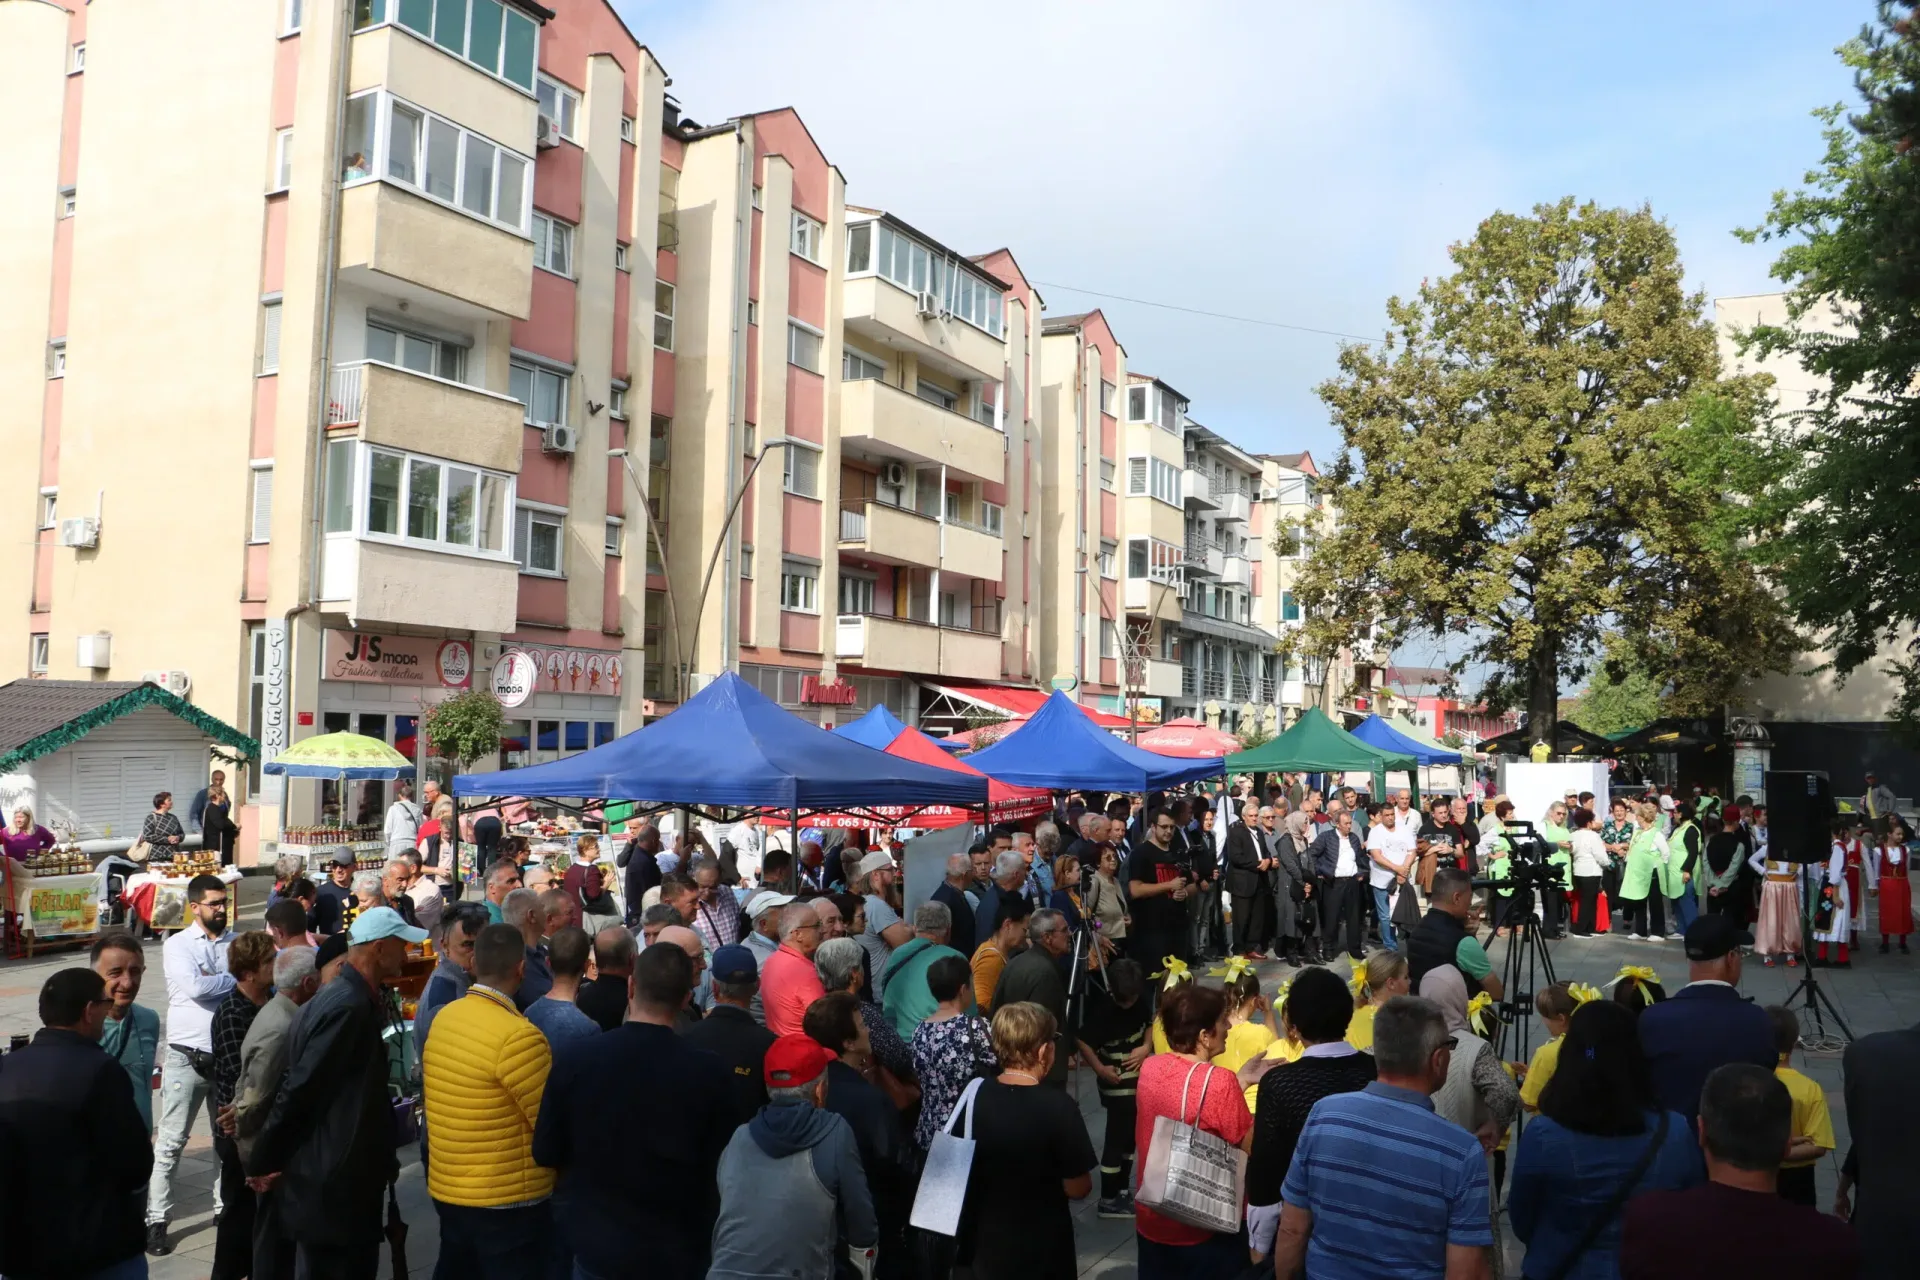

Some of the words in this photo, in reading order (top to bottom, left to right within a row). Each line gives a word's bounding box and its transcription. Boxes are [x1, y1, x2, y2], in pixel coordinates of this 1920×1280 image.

[332, 659, 378, 678] Fashion
[380, 666, 424, 680] collections
[812, 817, 834, 827] Tel.
[837, 817, 860, 827] 065
